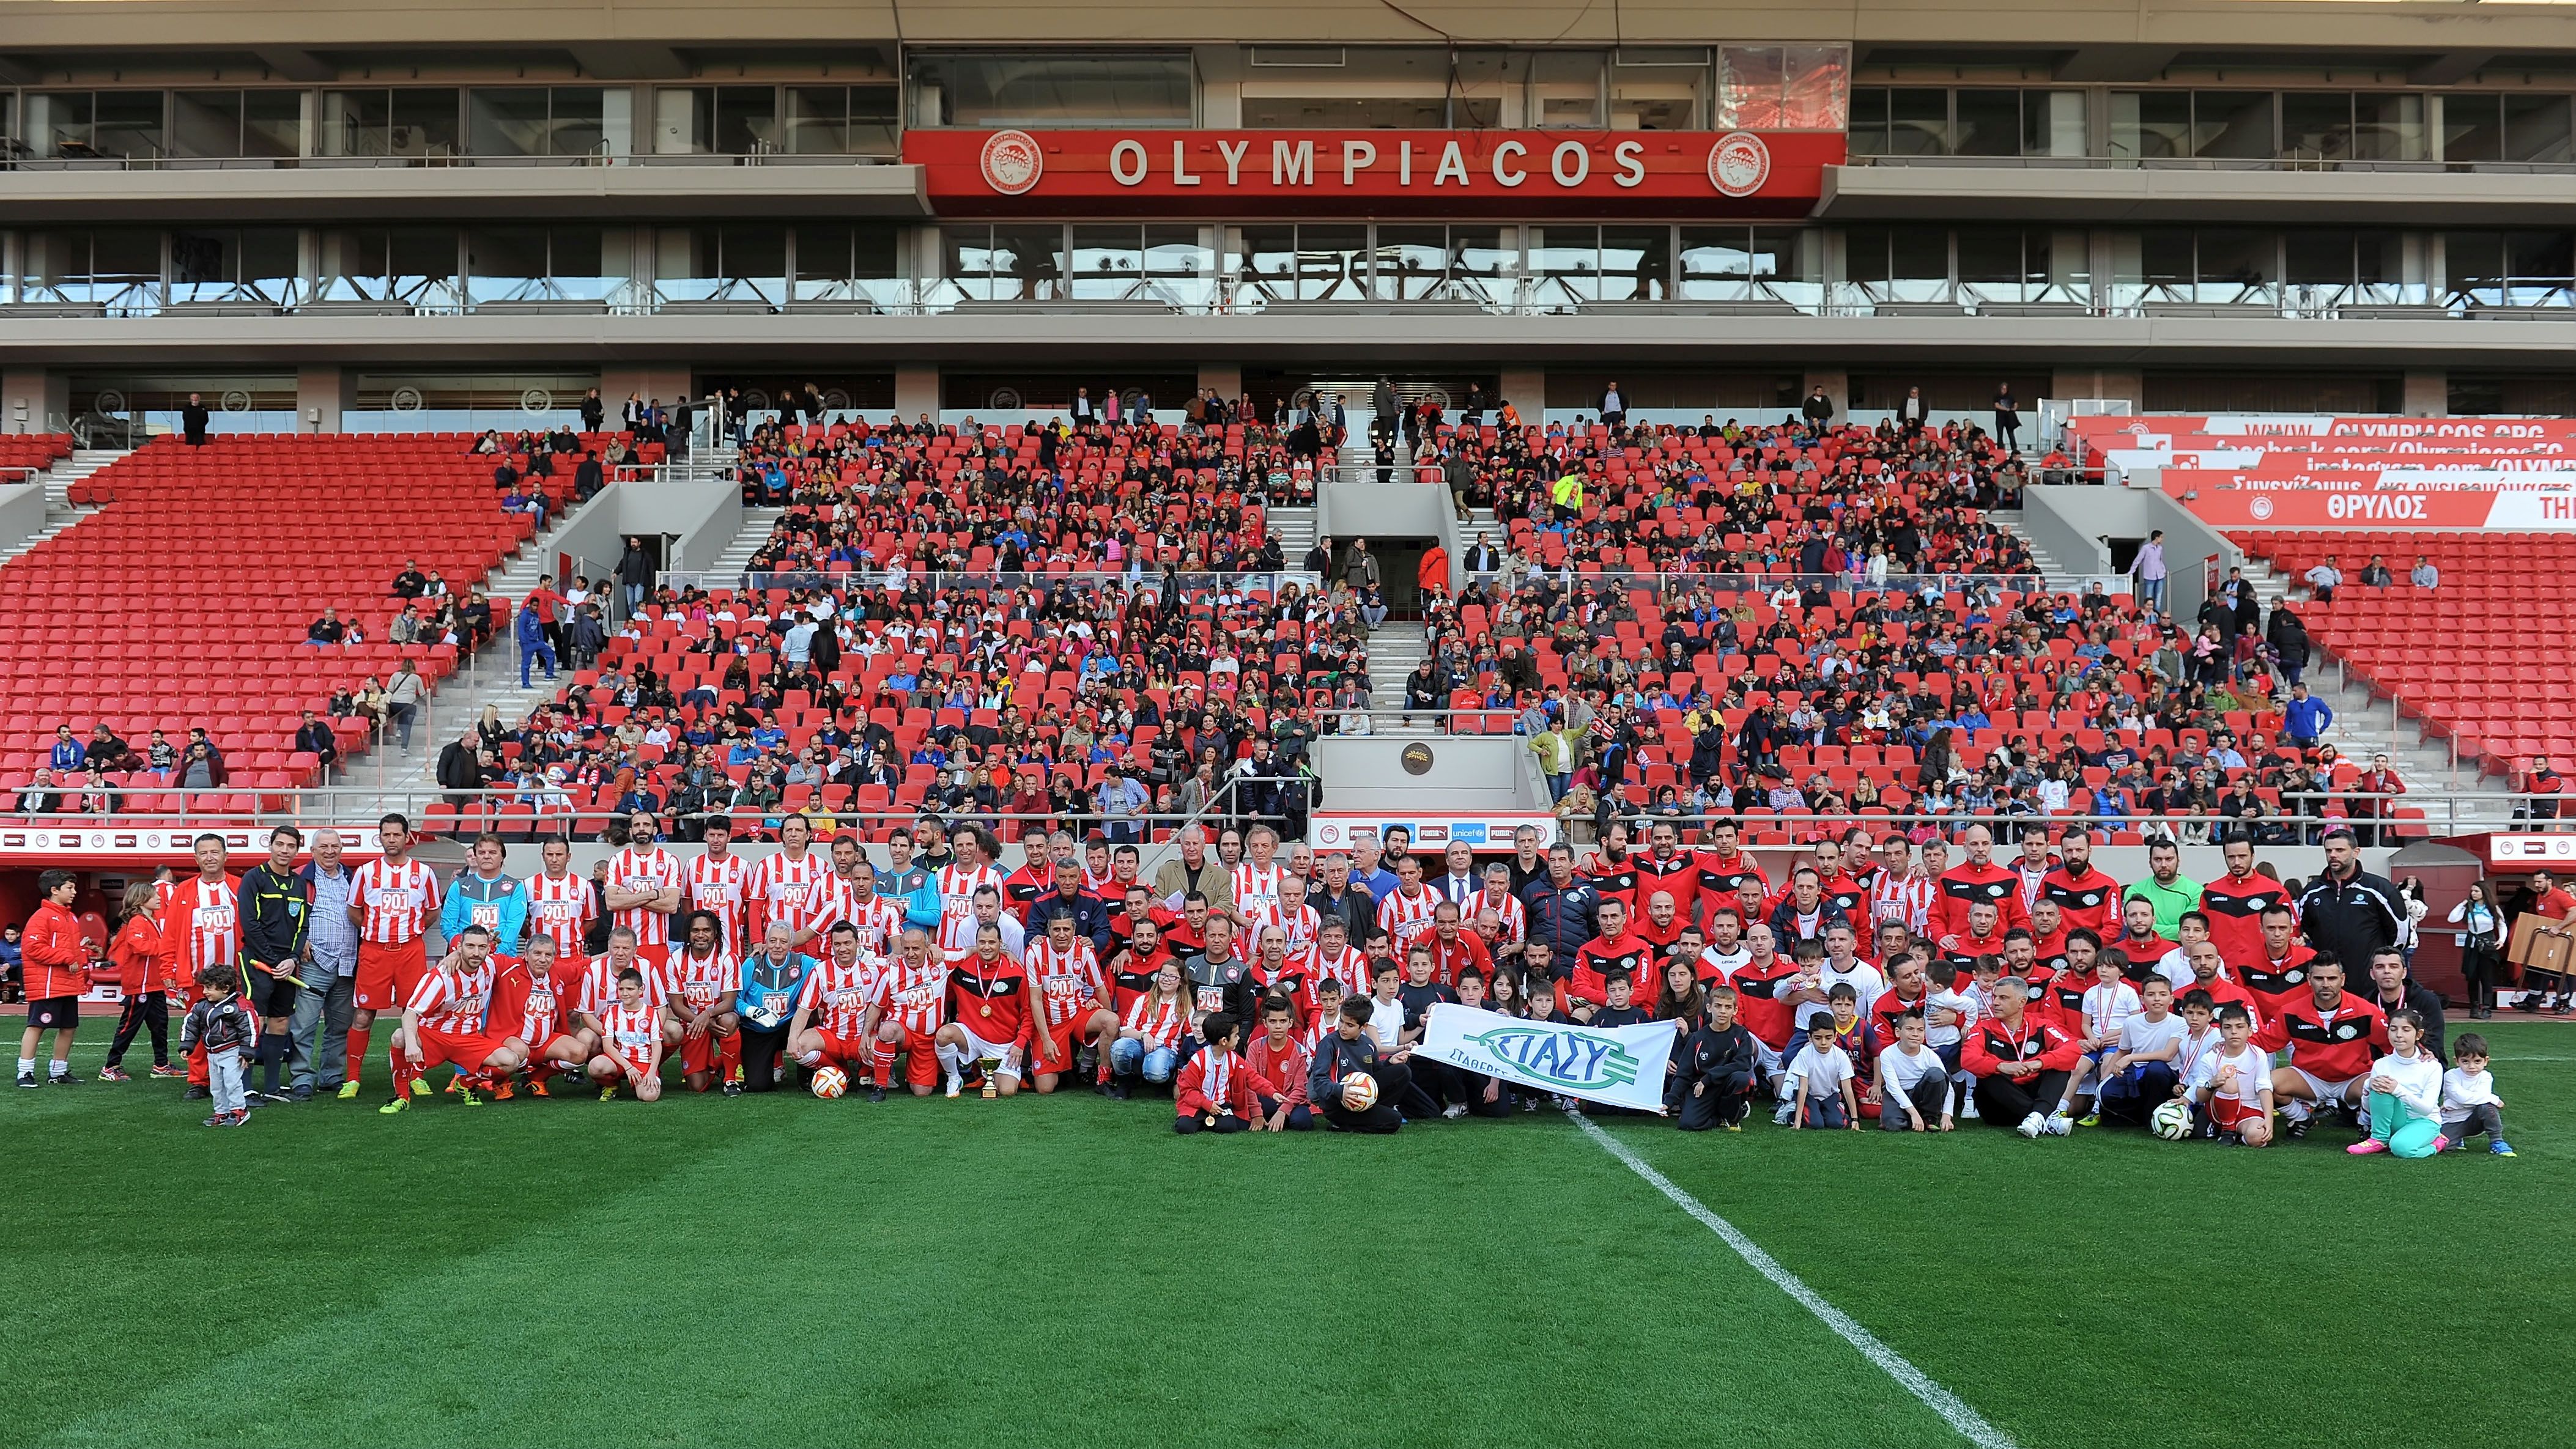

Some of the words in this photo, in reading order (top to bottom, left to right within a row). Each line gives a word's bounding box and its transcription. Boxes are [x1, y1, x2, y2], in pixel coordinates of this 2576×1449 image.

[1109, 140, 1645, 187] OLYMPIACOS
[2327, 495, 2428, 519] ΘΡΥΛΟΣ
[2539, 496, 2576, 519] TH
[1453, 828, 1475, 838] unicef
[633, 881, 656, 894] 901
